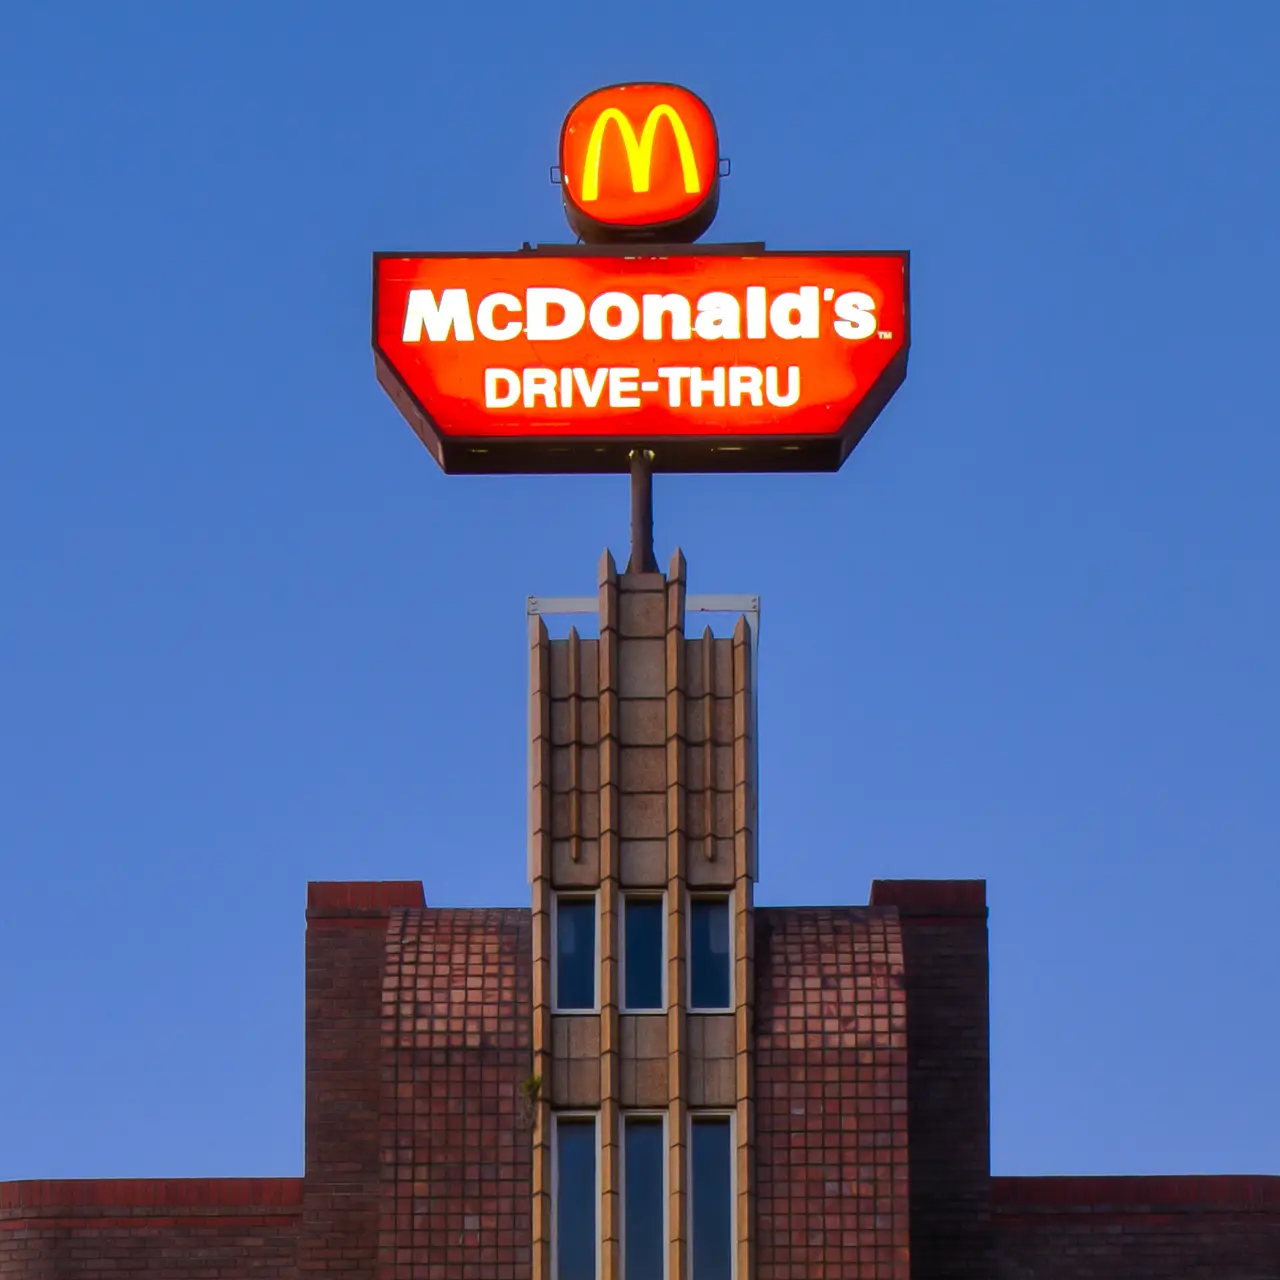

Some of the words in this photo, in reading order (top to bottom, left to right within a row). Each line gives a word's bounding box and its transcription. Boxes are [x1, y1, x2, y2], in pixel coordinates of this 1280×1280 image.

[581, 104, 701, 201] M
[402, 286, 877, 342] McDonald's
[484, 366, 801, 408] DRIVE-THRU
